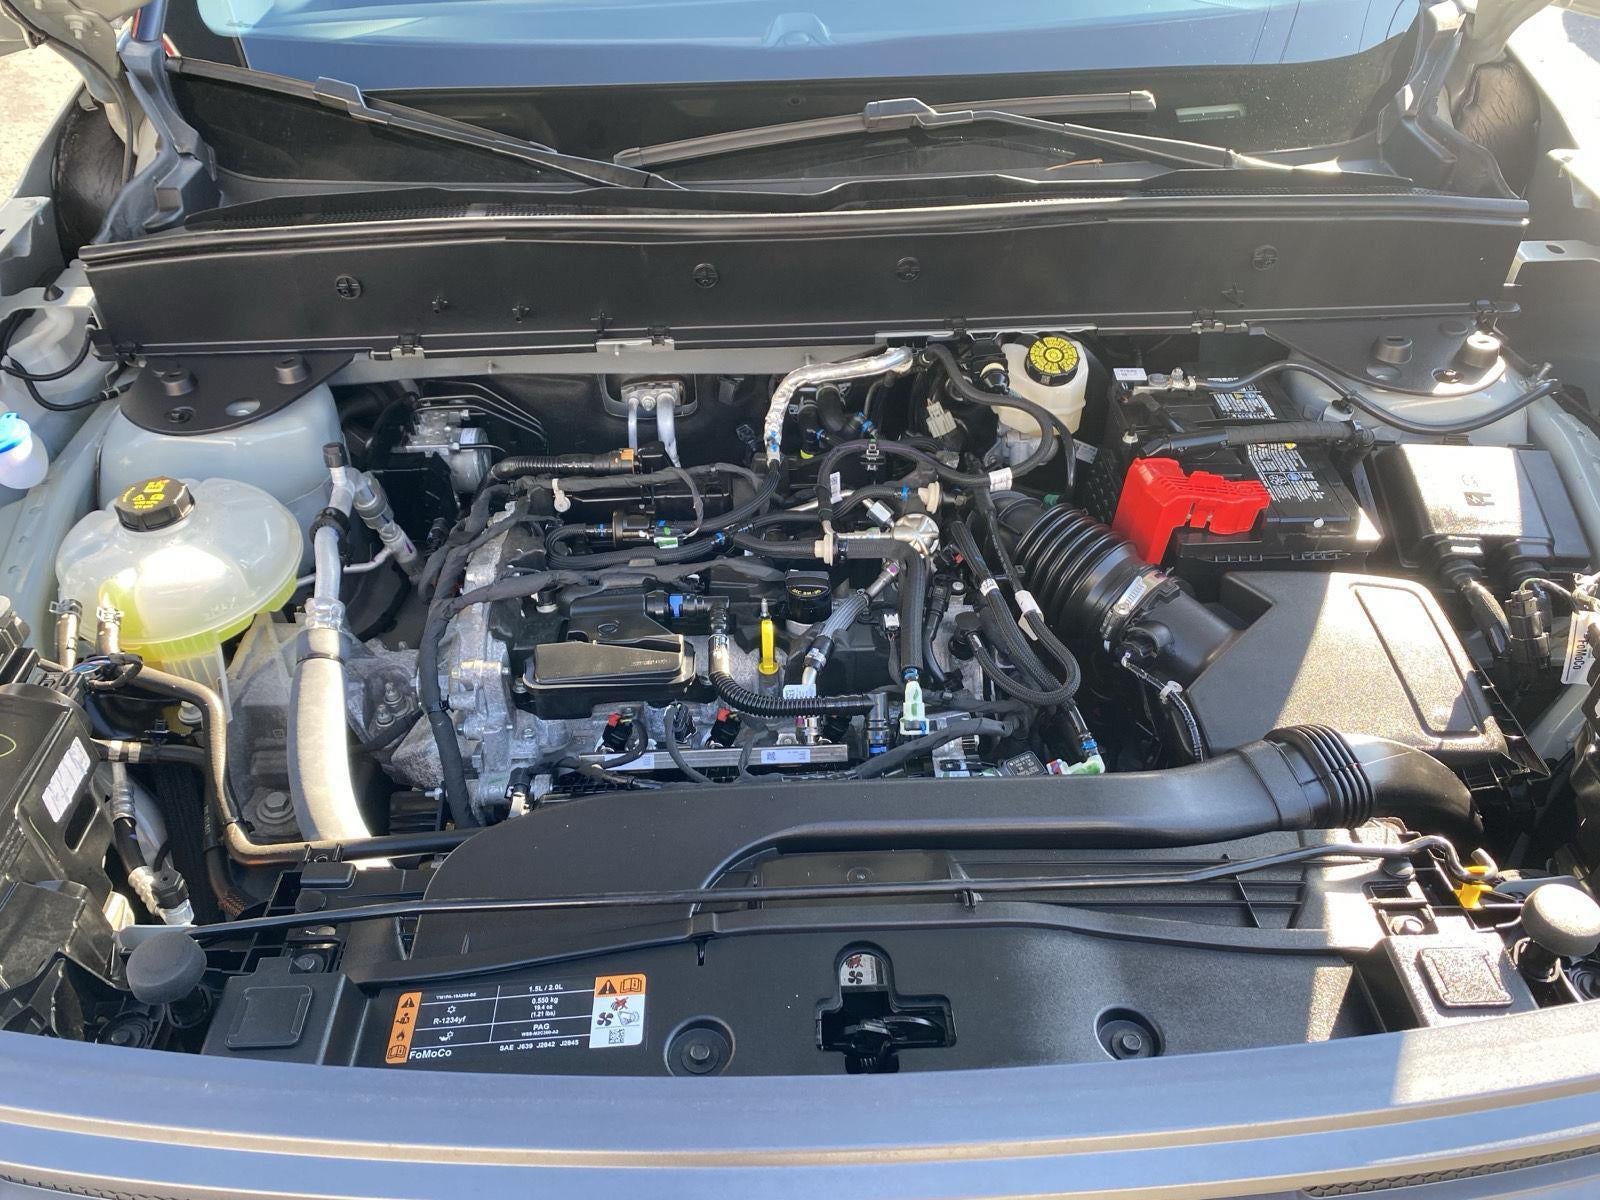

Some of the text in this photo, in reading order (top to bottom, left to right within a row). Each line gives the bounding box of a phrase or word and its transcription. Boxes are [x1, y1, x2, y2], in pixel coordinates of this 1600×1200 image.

[1573, 639, 1588, 670] FoMoCo
[433, 1015, 466, 1025] R-1234yf
[533, 1023, 550, 1031] PAG
[499, 1044, 514, 1052] SAE
[409, 1048, 452, 1060] FoMoCo
